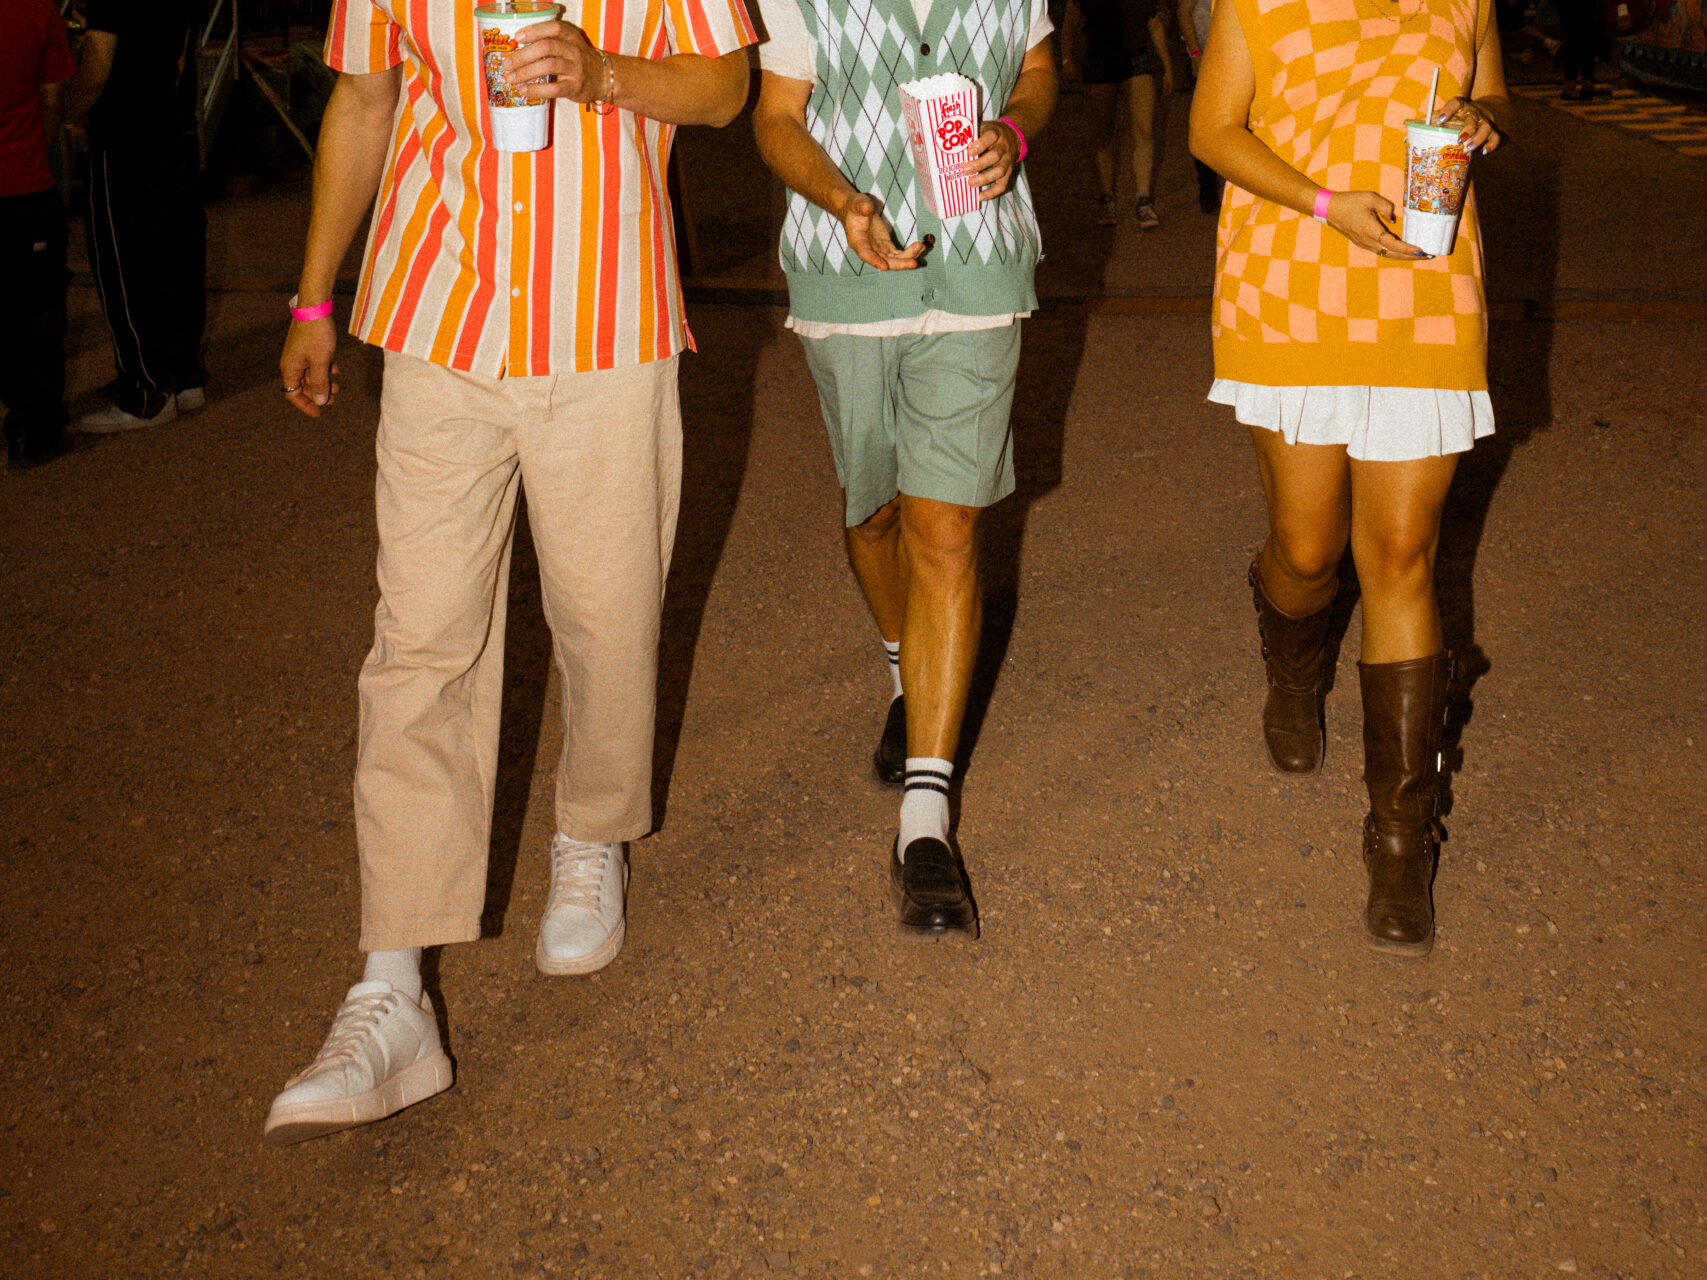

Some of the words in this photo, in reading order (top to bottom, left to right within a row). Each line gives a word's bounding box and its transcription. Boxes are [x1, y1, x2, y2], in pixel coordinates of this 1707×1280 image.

[941, 100, 961, 118] fresh
[937, 119, 963, 140] POP
[942, 125, 973, 151] CORN
[938, 161, 965, 175] DELICIOU
